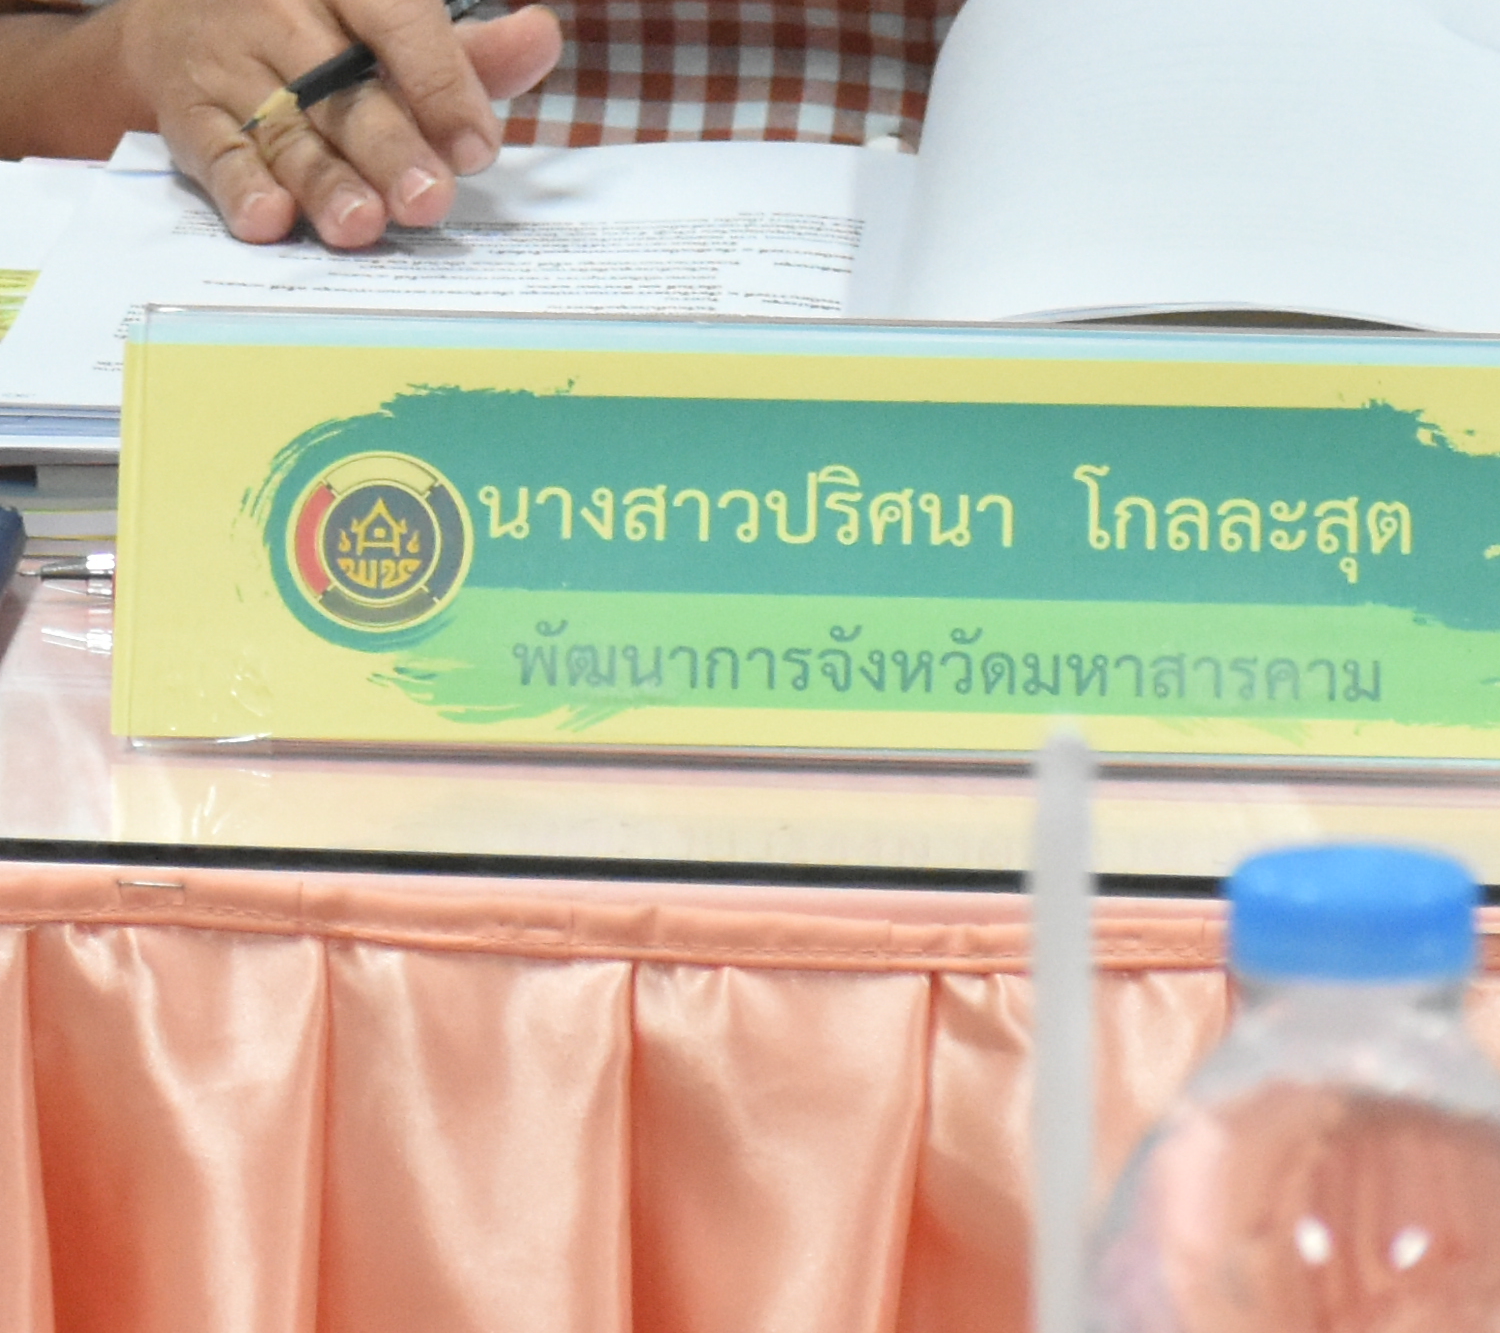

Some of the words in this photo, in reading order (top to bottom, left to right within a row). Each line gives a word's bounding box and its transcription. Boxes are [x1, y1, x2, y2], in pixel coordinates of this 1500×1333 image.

[477, 463, 1014, 549] นางสาวปริศนา
[1073, 464, 1414, 584] โกลละสุต
[511, 619, 1383, 703] พัฒนาการจังหวัดมหาสารคาม
